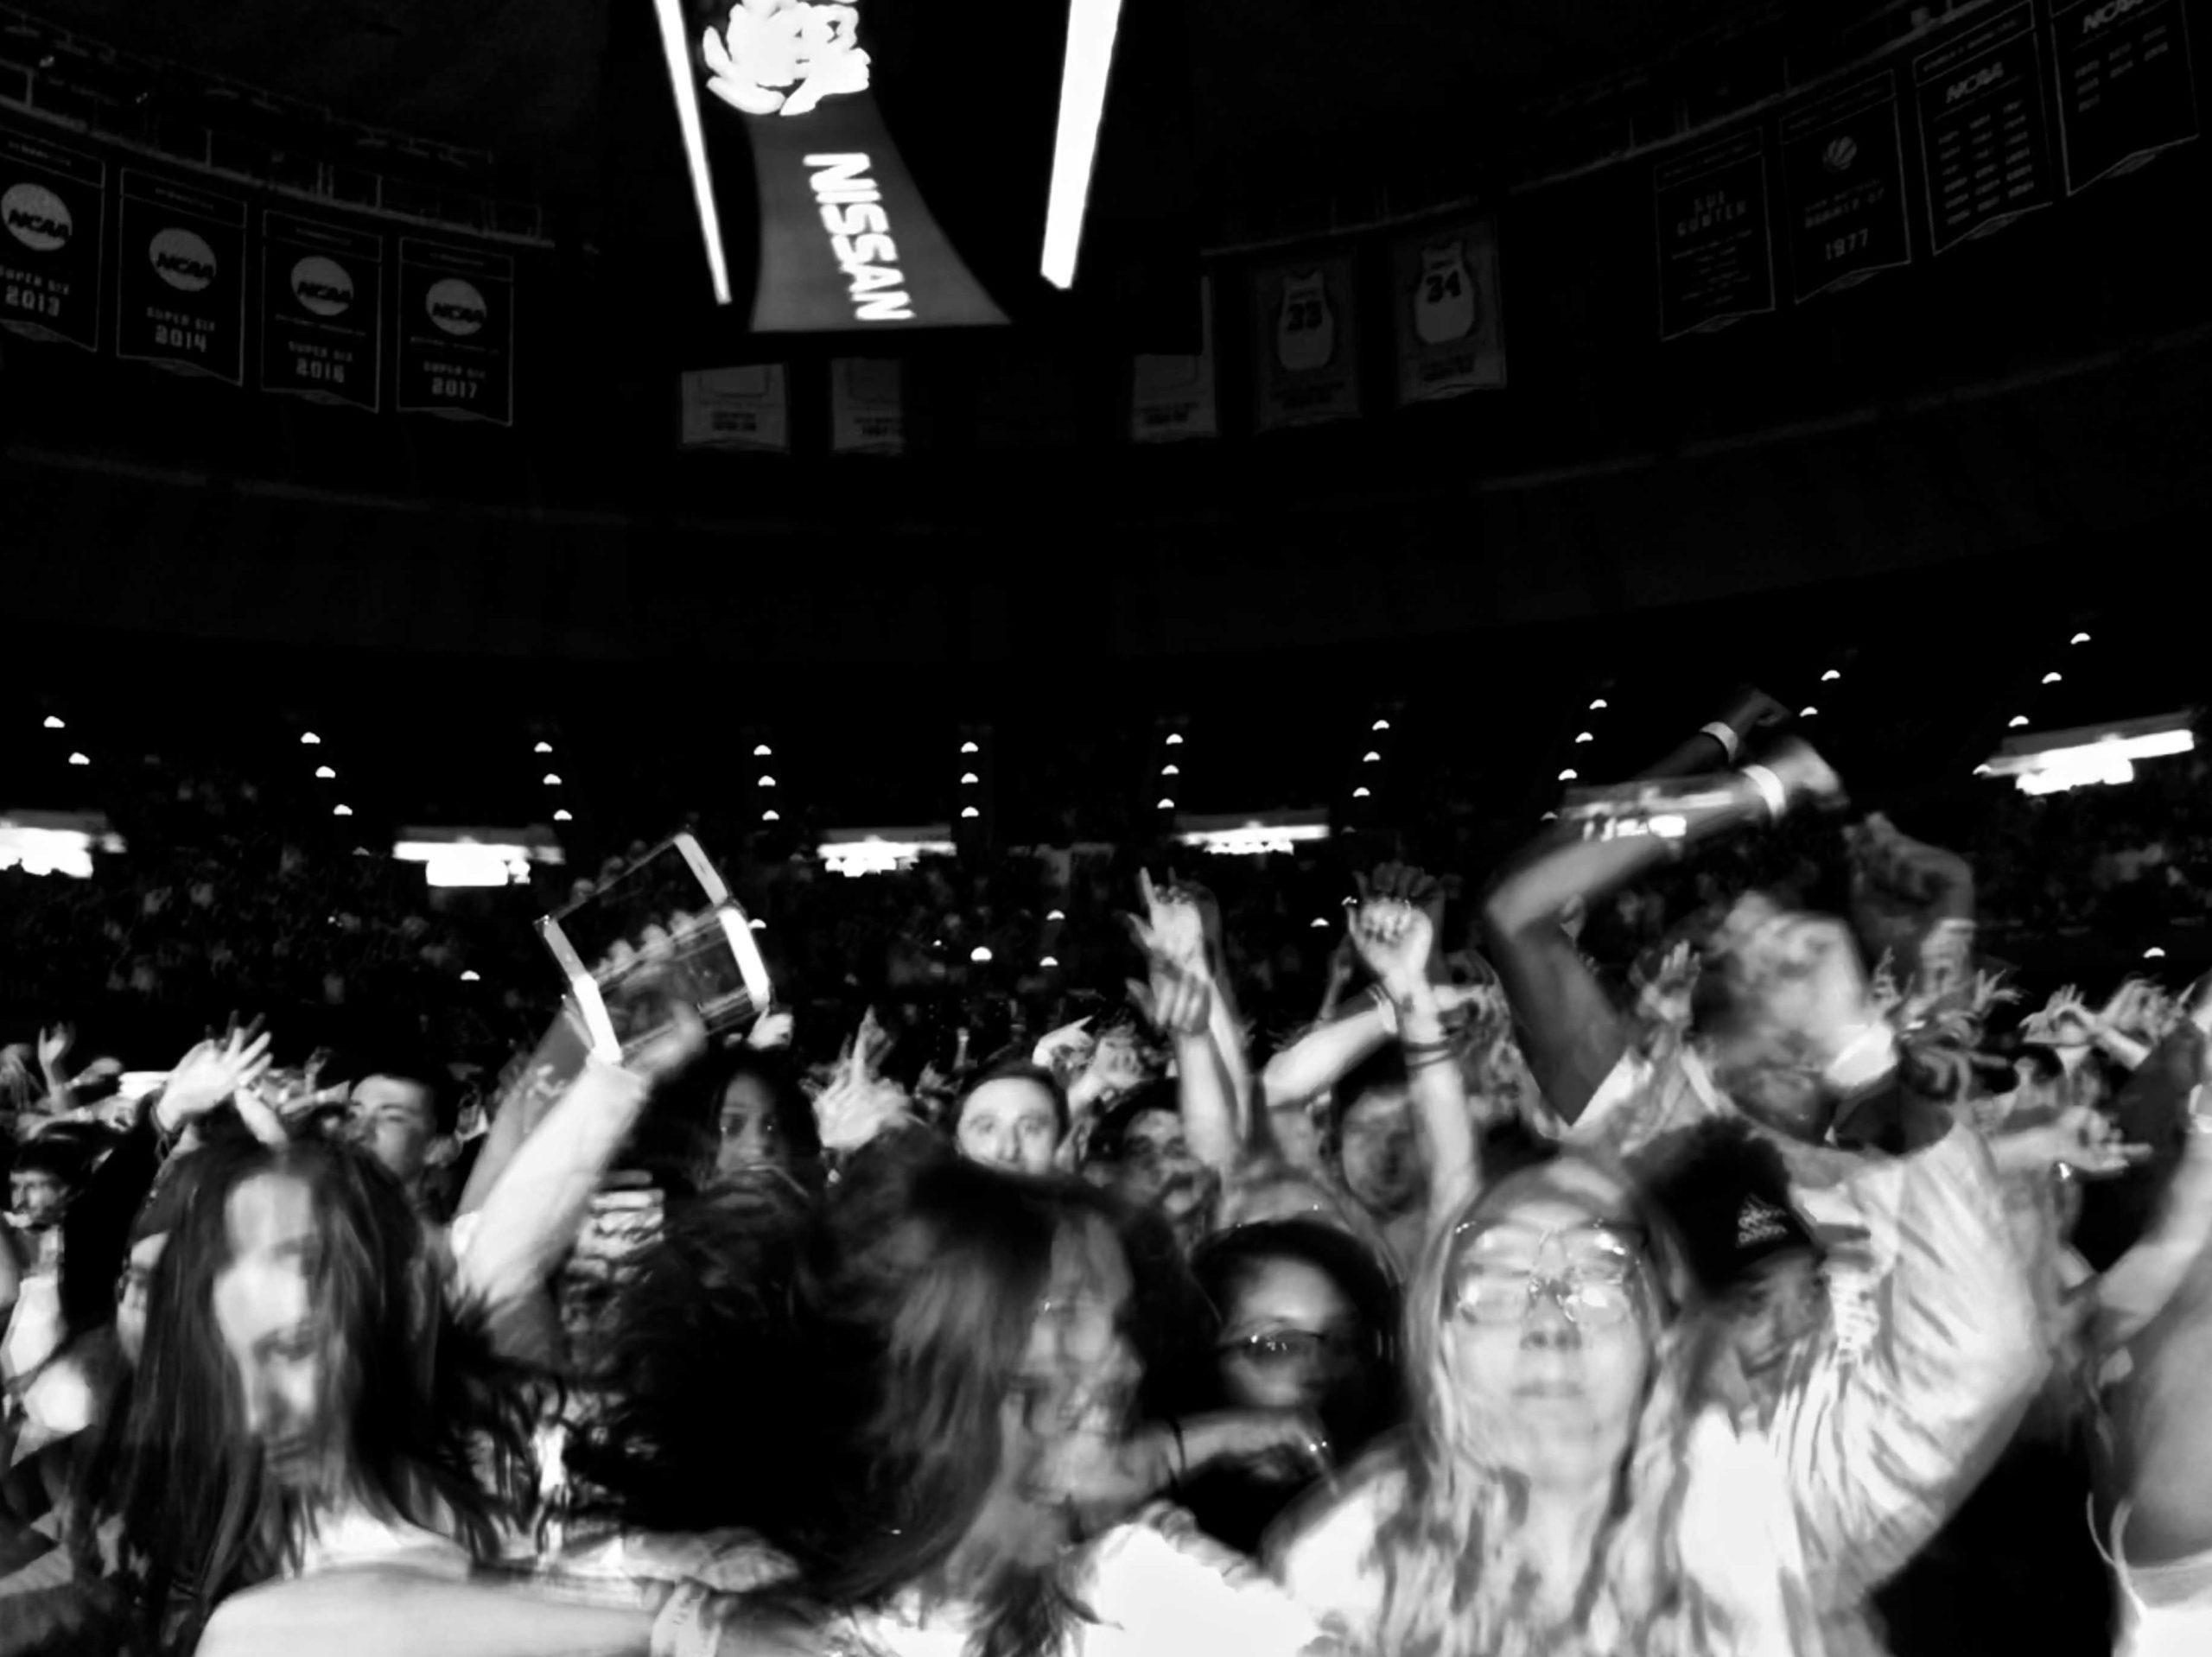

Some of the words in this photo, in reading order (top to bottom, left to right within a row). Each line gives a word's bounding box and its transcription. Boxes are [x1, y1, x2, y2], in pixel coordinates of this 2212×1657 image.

[9, 208, 69, 240] NCAA
[803, 152, 916, 321] NISSAN
[1825, 227, 1869, 262] 1977
[156, 252, 215, 278] NCAA
[297, 281, 351, 302] NCAA
[432, 302, 485, 322] NCAA
[154, 323, 208, 352] 2014
[430, 376, 479, 399] 2017
